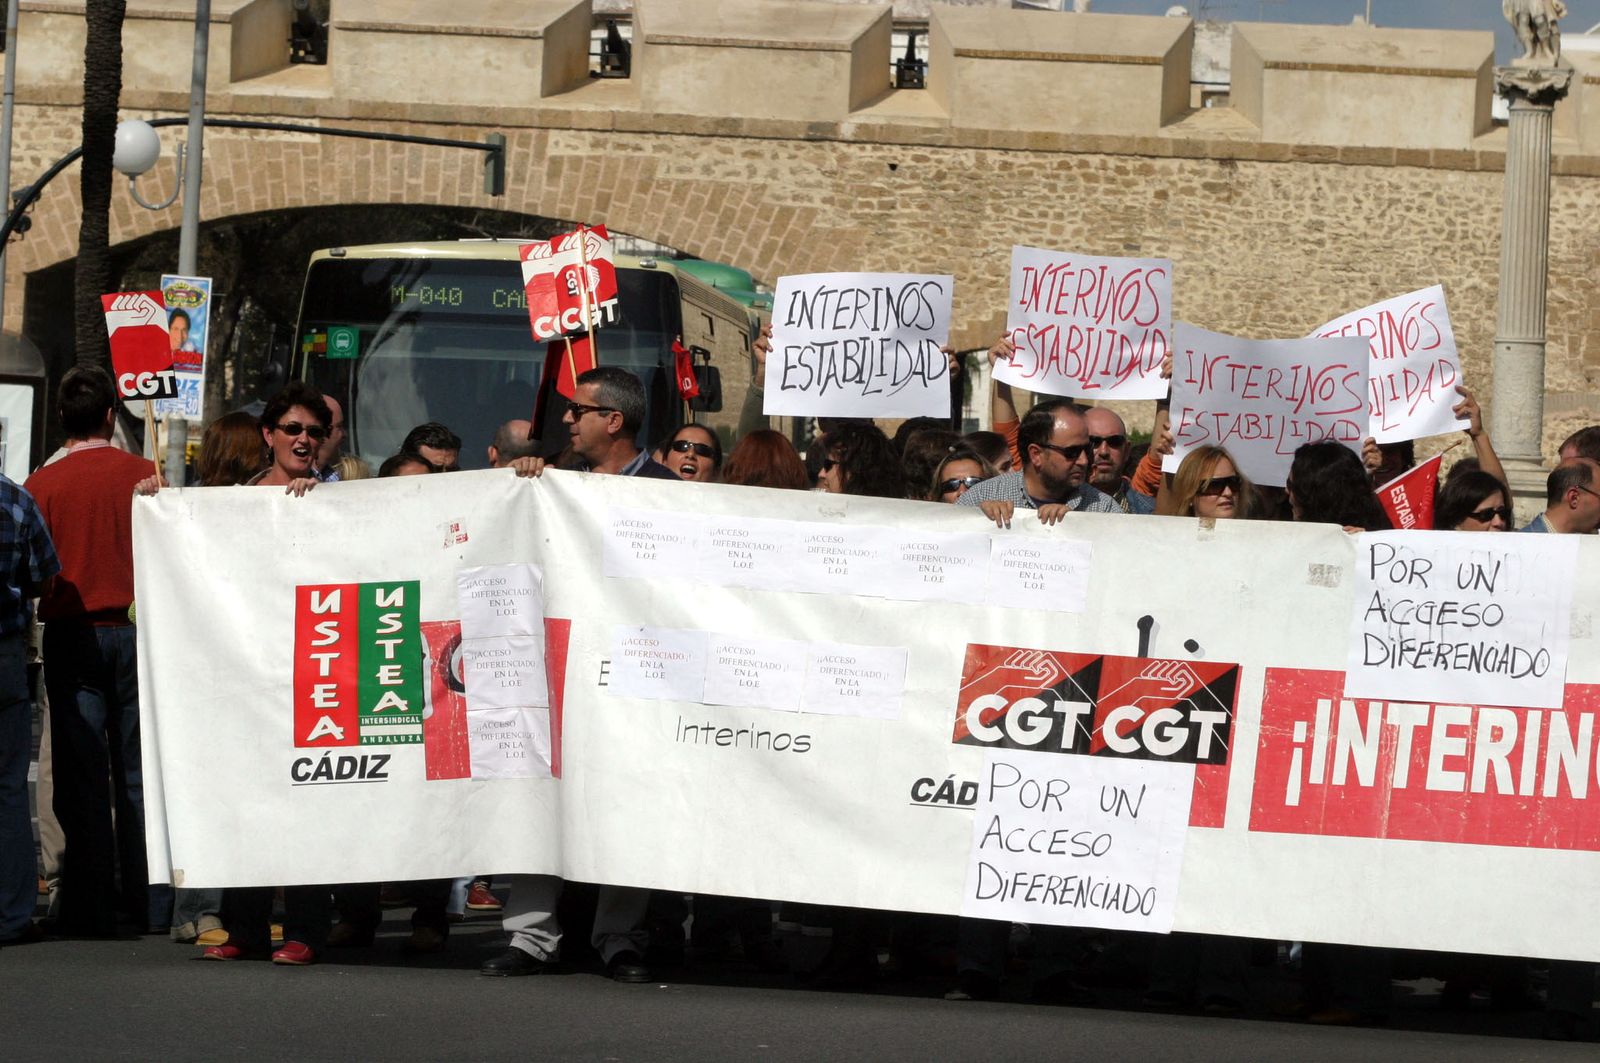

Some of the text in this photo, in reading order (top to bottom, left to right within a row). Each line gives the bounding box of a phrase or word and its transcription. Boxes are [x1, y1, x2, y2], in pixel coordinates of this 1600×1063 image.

[391, 285, 463, 306] M-040
[565, 270, 580, 296] CGT
[1019, 262, 1166, 327] INTERINOS
[783, 280, 944, 332] INTERINOS
[781, 336, 947, 398] ESTABILIDAD
[1008, 325, 1167, 390] ESTABILIDAD
[118, 369, 176, 397] CGT
[1185, 350, 1363, 416] INTERINOS
[1177, 407, 1360, 455] ESTABILIDAD
[631, 541, 643, 549] EN
[728, 550, 740, 558] EN
[823, 557, 835, 565] EN
[918, 564, 943, 573] EN LA
[1019, 571, 1044, 580] EN LA
[1369, 542, 1500, 593] POR UN
[489, 598, 514, 607] EN LA
[1364, 590, 1504, 627] ACCESO
[306, 588, 345, 741] USTEA
[373, 586, 409, 713] USTEA
[640, 660, 664, 669] EN LA
[494, 669, 519, 678] EN LA
[734, 668, 759, 678] EN LA
[834, 678, 859, 687] EN LA
[361, 716, 421, 725] INTERSINDICAL
[675, 715, 812, 753] Interinos
[966, 694, 1227, 760] CGT CGT
[362, 735, 421, 744] ANDALUZA
[499, 742, 510, 750] EN
[1284, 698, 1600, 807] ¡INTERIN
[291, 750, 391, 782] CÁDIZ
[989, 762, 1147, 819] POR UN
[980, 815, 1112, 857] ACCESO
